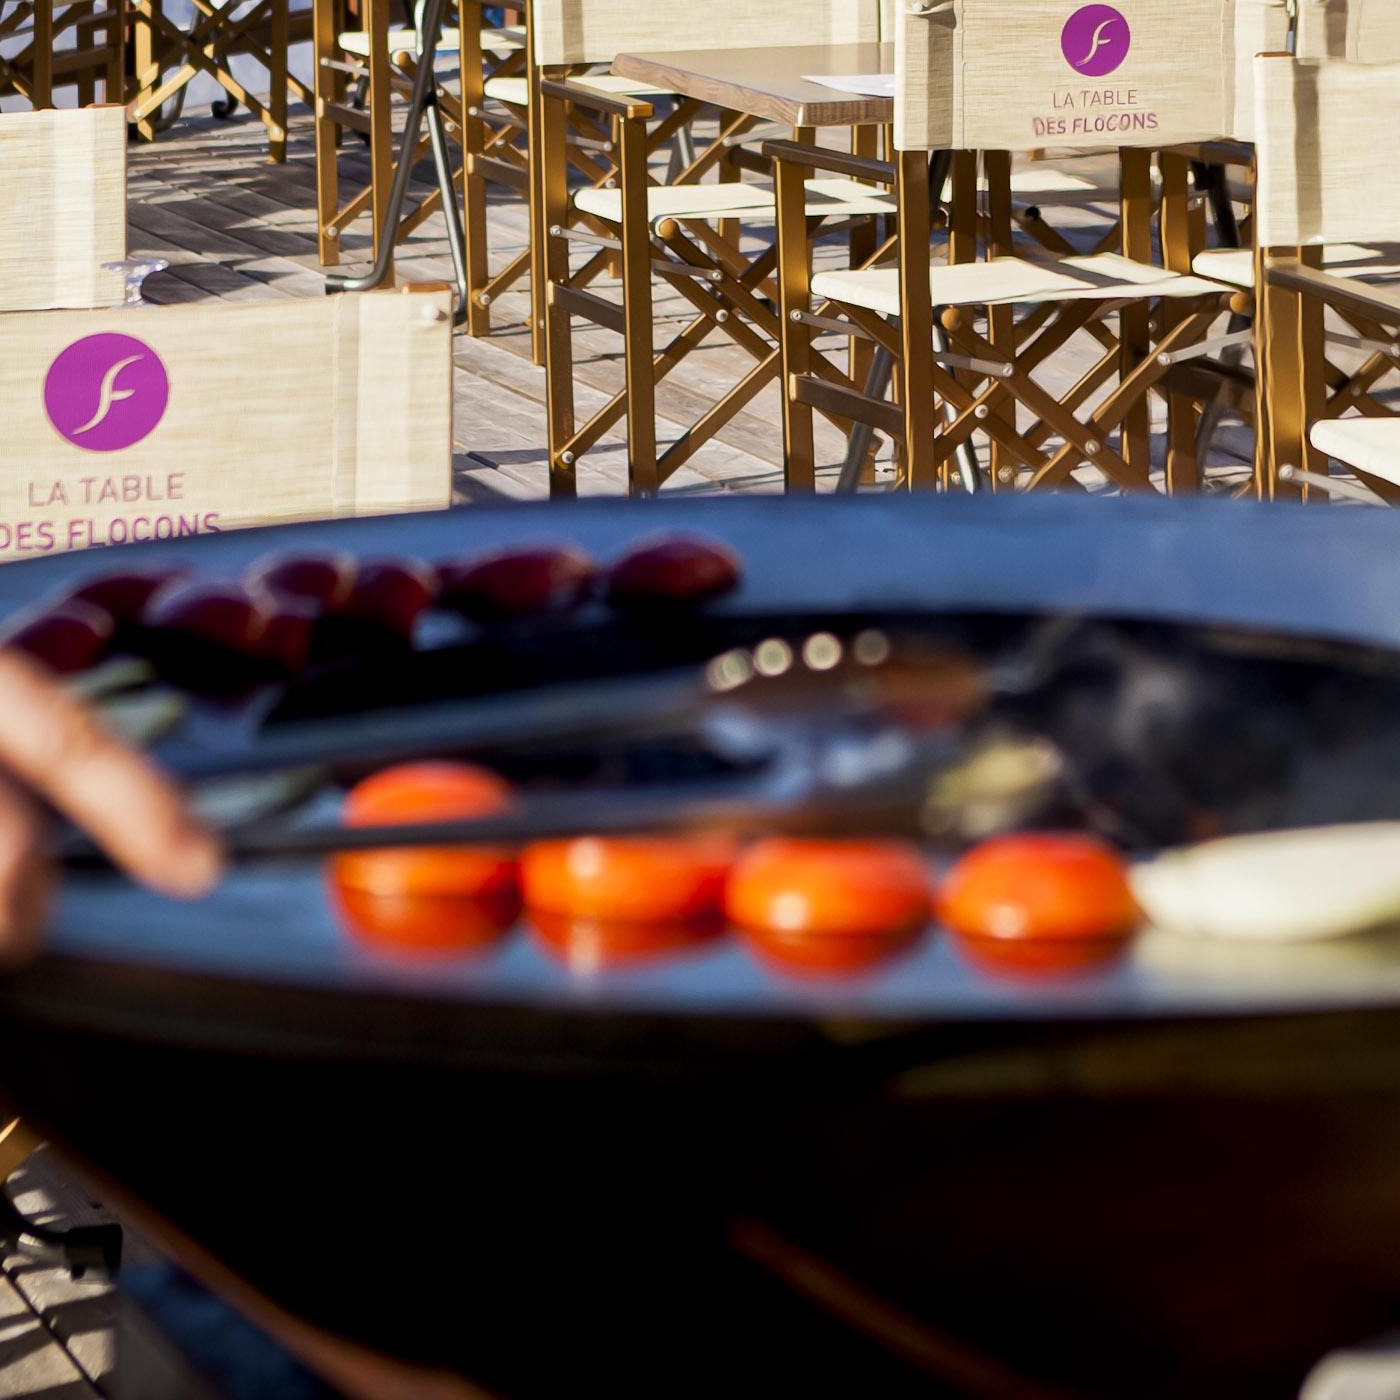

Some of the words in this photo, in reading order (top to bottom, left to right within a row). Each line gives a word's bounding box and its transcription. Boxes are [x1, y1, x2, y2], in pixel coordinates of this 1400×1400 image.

[1052, 90, 1075, 110] LA
[1080, 89, 1138, 108] TABLE
[1032, 116, 1066, 137] DES
[1072, 112, 1159, 135] FLOCONS
[27, 478, 70, 508] LA
[79, 472, 186, 505] TABLE
[66, 512, 224, 550] FLOCONS
